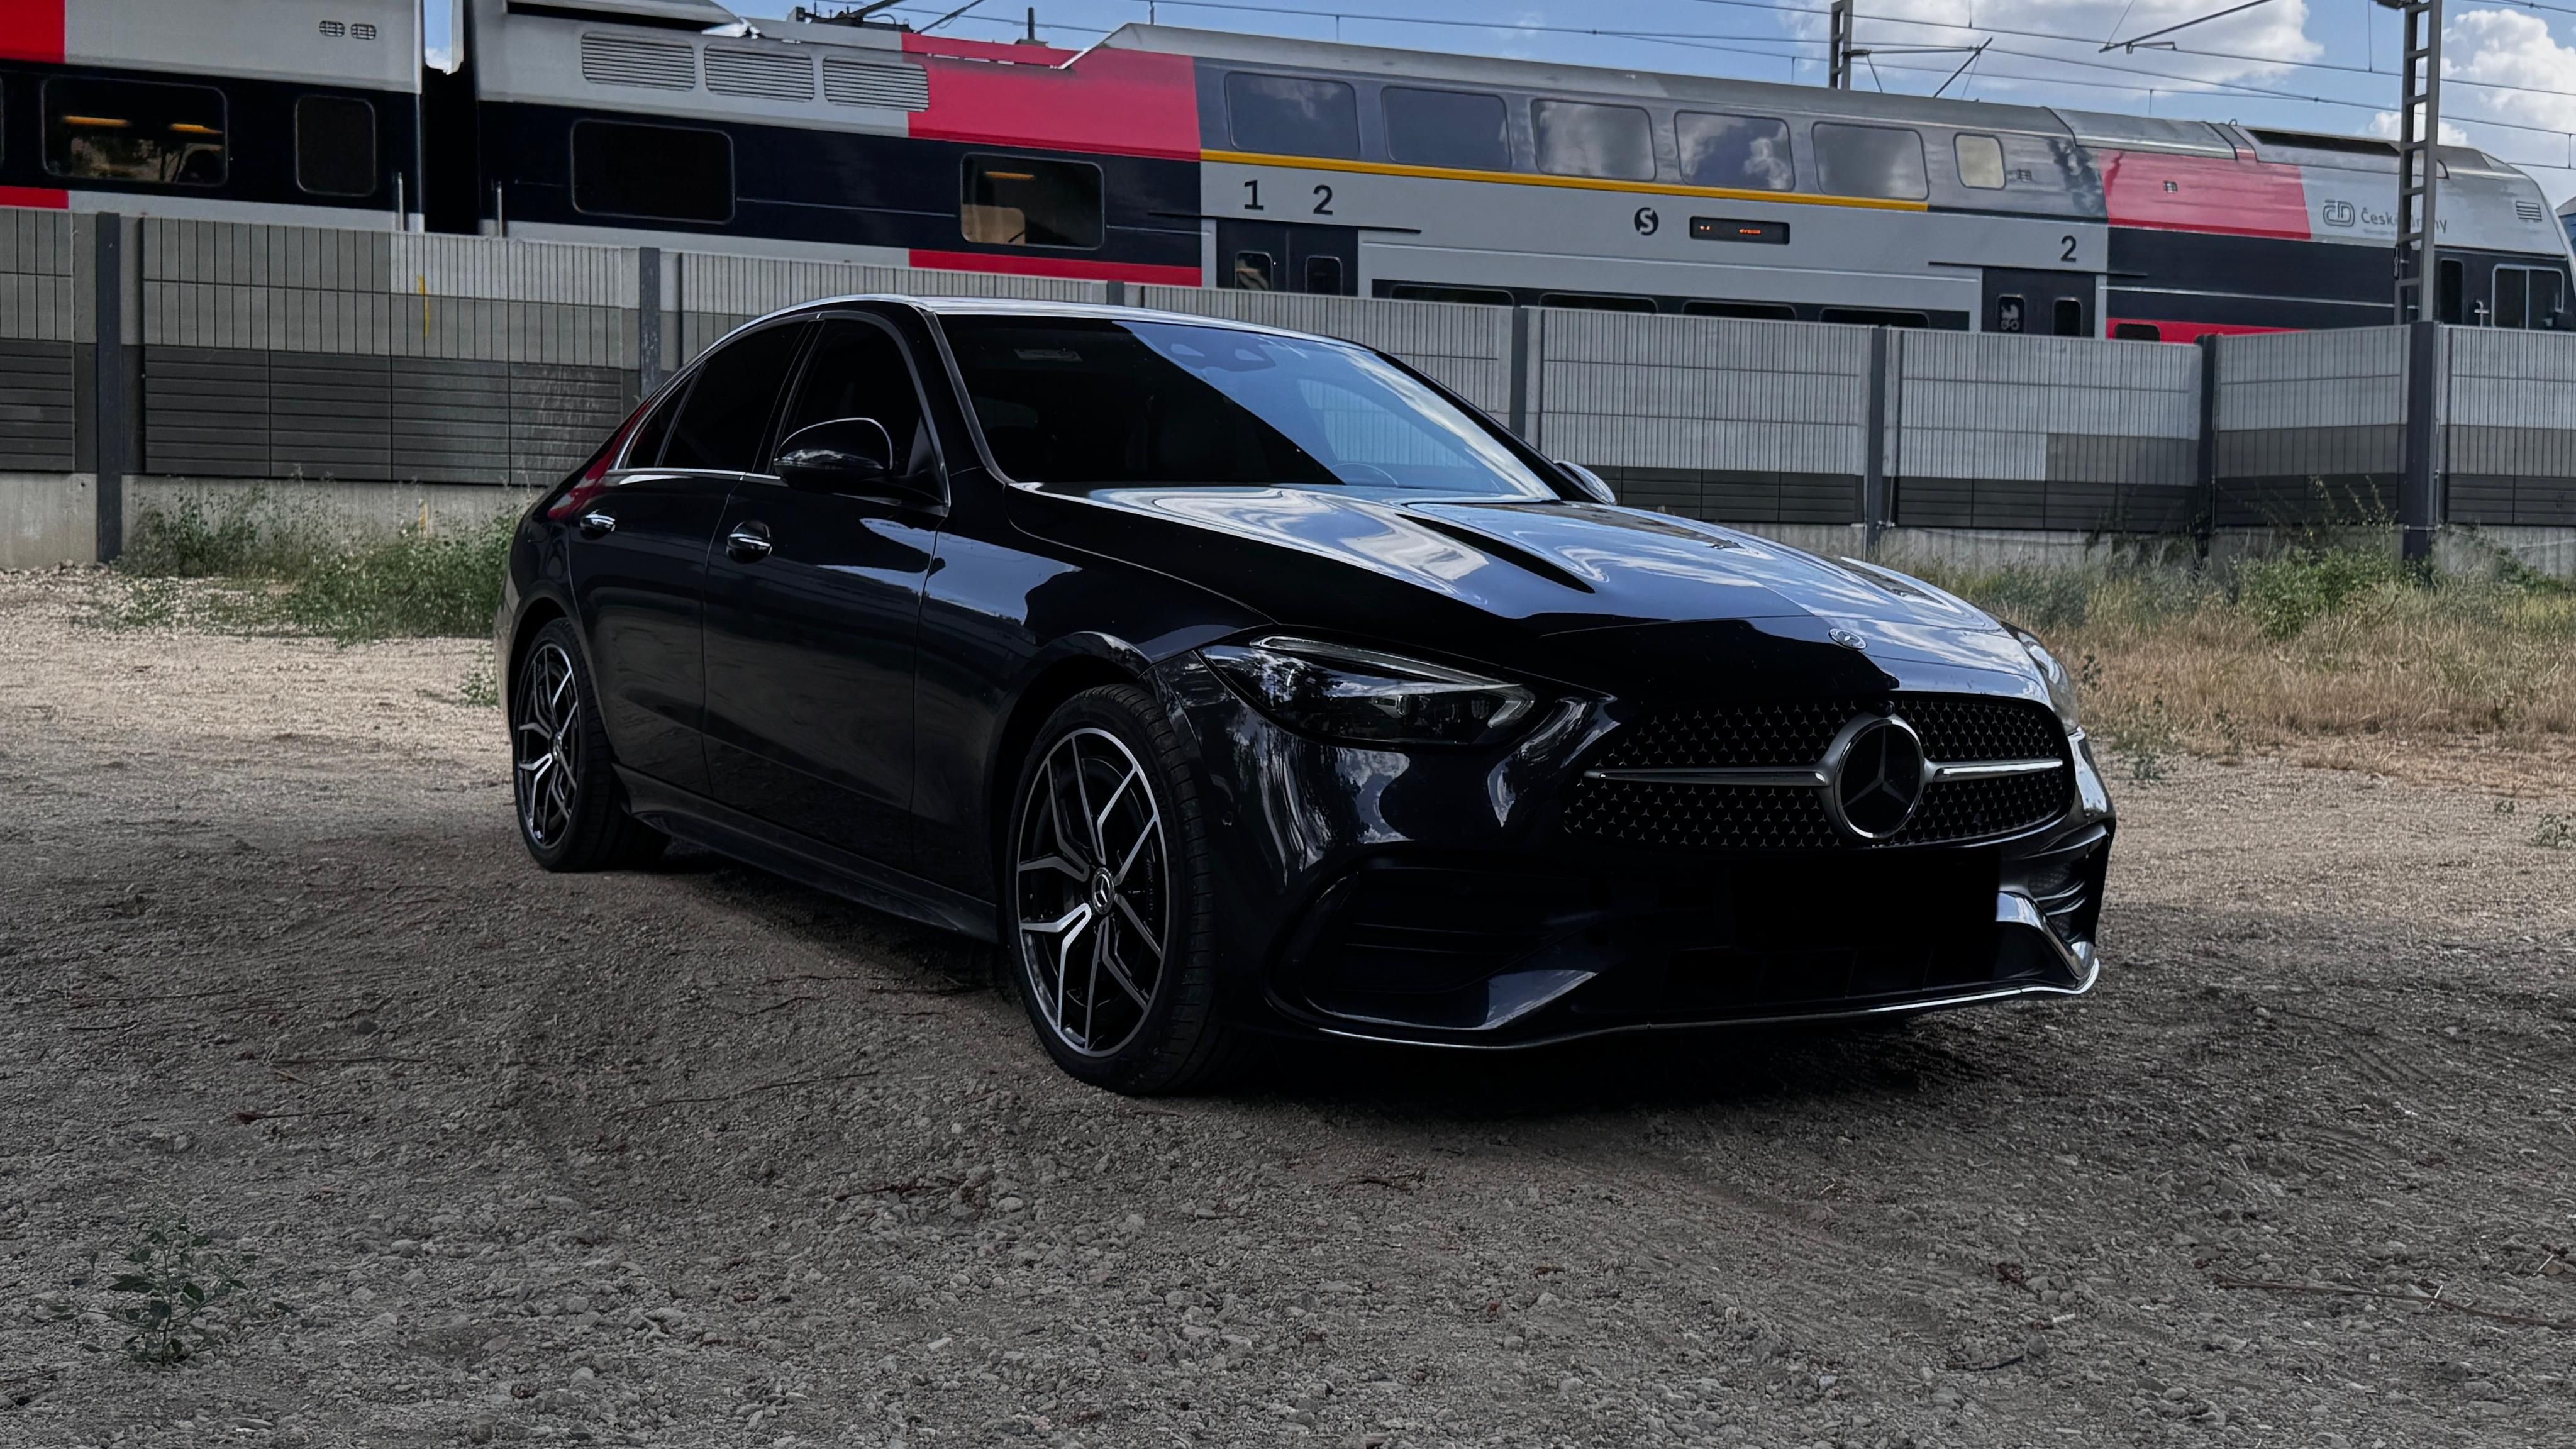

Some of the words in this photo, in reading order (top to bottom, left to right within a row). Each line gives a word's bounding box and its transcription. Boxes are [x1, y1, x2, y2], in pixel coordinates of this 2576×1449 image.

[1244, 180, 1264, 211] 1
[1313, 184, 1333, 215] 2
[2361, 206, 2398, 226] Česk
[2060, 235, 2077, 262] 2
